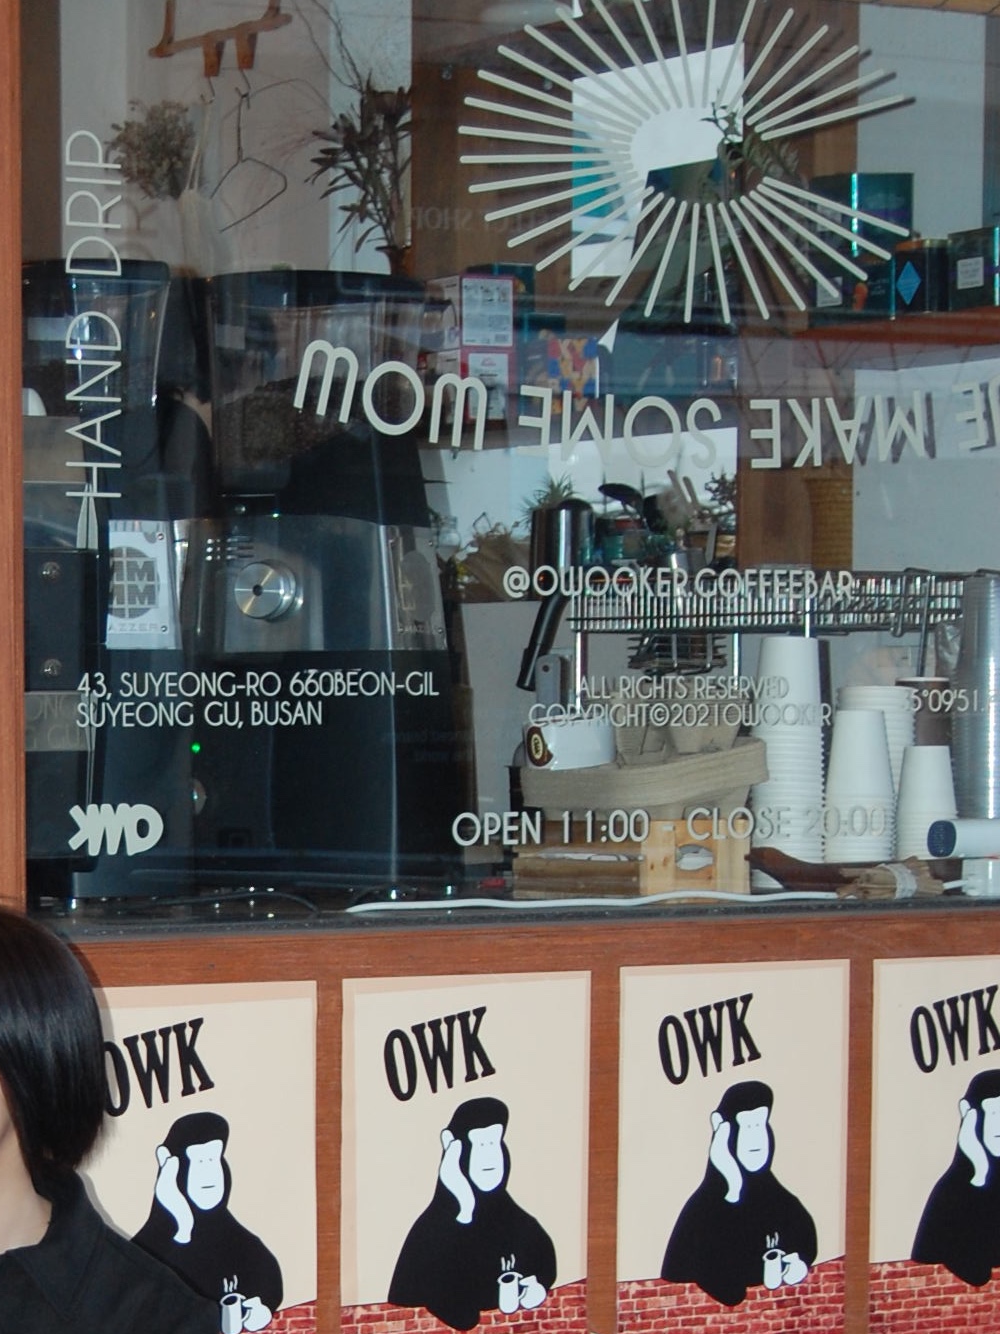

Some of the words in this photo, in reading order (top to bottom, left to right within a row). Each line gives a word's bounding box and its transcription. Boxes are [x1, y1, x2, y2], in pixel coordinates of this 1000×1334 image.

[66, 130, 122, 277] DRIP
[66, 311, 122, 498] HAND
[518, 384, 722, 470] SOME
[749, 389, 928, 470] MAKE
[75, 701, 194, 728] SUYEONG
[203, 700, 244, 729] GU,
[250, 700, 323, 727] BUSAN
[76, 671, 113, 700] 43,
[119, 671, 282, 698] SUYEONG-RO
[288, 670, 440, 697] 660BEON-GIL
[578, 675, 612, 700] ALL
[619, 675, 688, 700] RIGHTS
[695, 675, 790, 700] RESERVED
[451, 810, 542, 847] OPEN
[560, 808, 650, 845] 11:00
[686, 806, 792, 842] CLOSE
[803, 805, 888, 838] 20:00
[102, 1017, 215, 1117] OWK
[384, 1005, 496, 1102] OWK
[658, 992, 762, 1085] OWK
[909, 983, 1000, 1073] OWK
